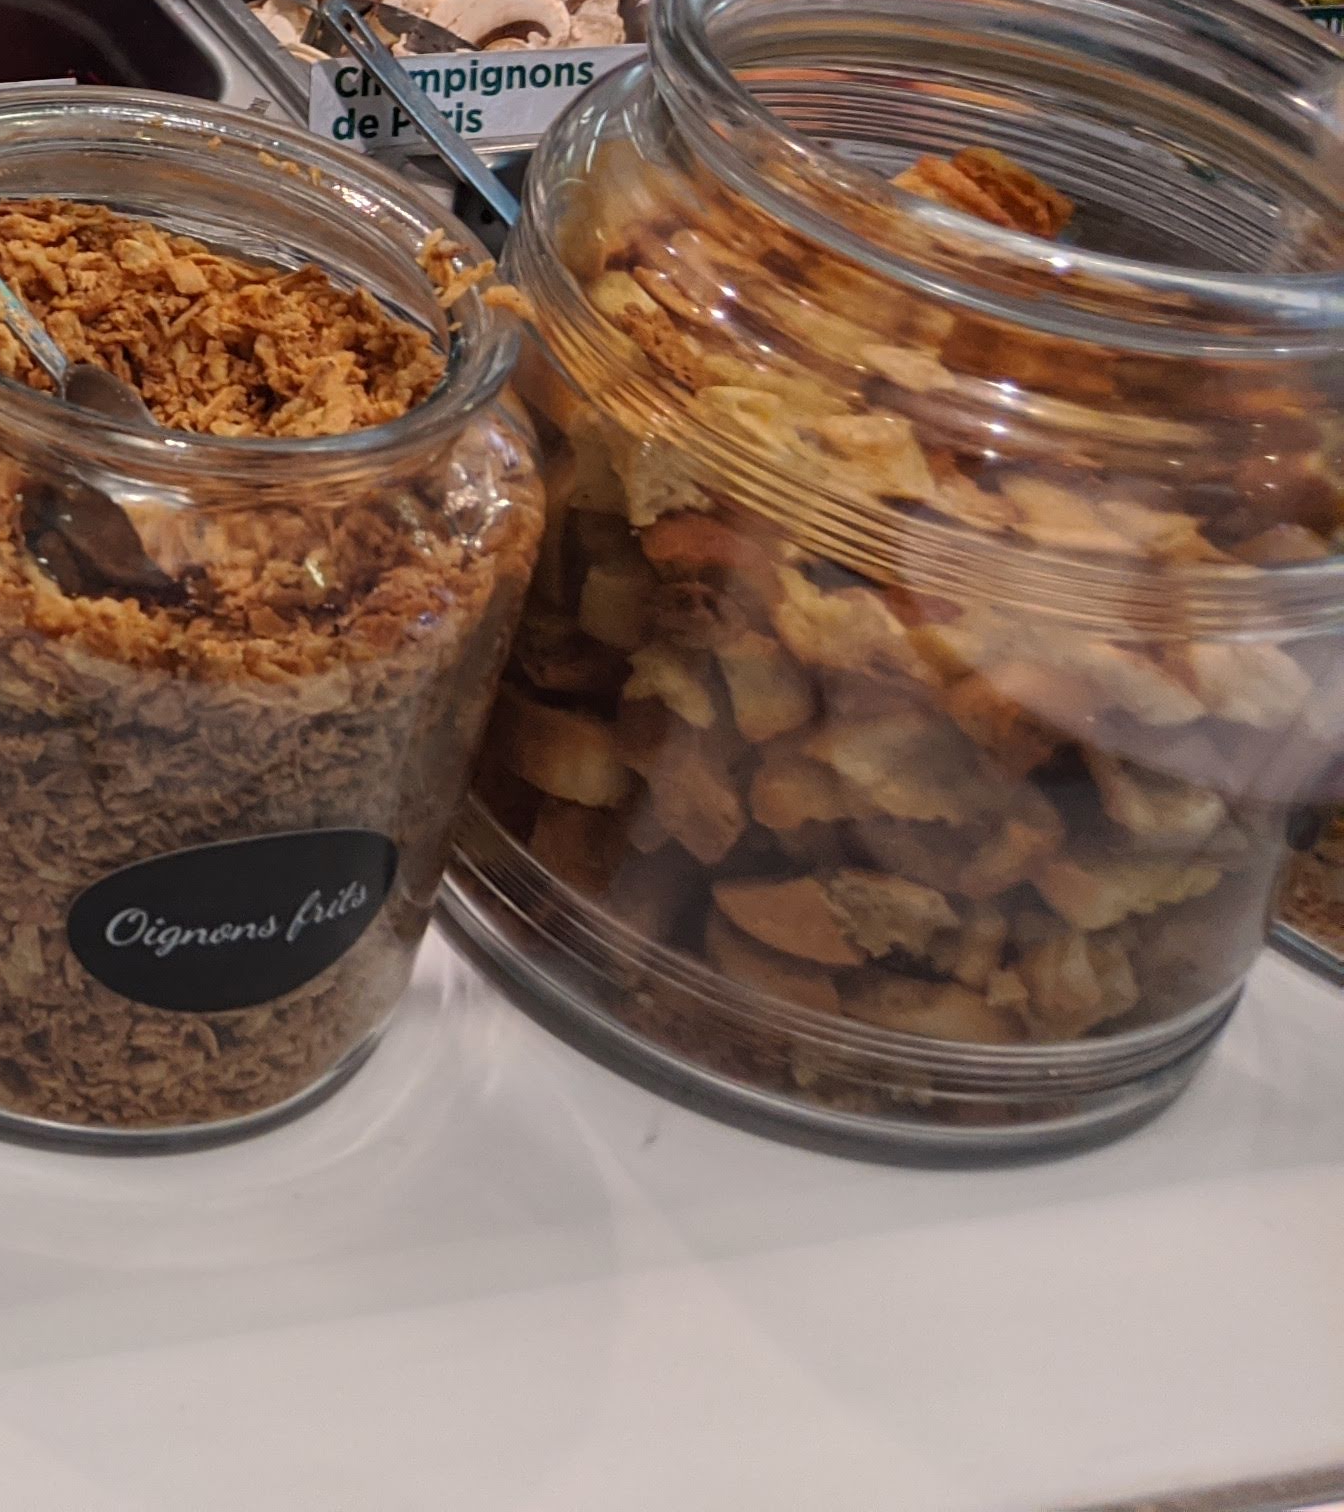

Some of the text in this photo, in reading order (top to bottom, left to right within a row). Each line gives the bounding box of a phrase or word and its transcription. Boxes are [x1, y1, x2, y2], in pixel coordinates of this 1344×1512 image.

[335, 59, 594, 98] Chmpignons
[332, 107, 380, 141] de
[104, 881, 368, 958] Oignons frits
